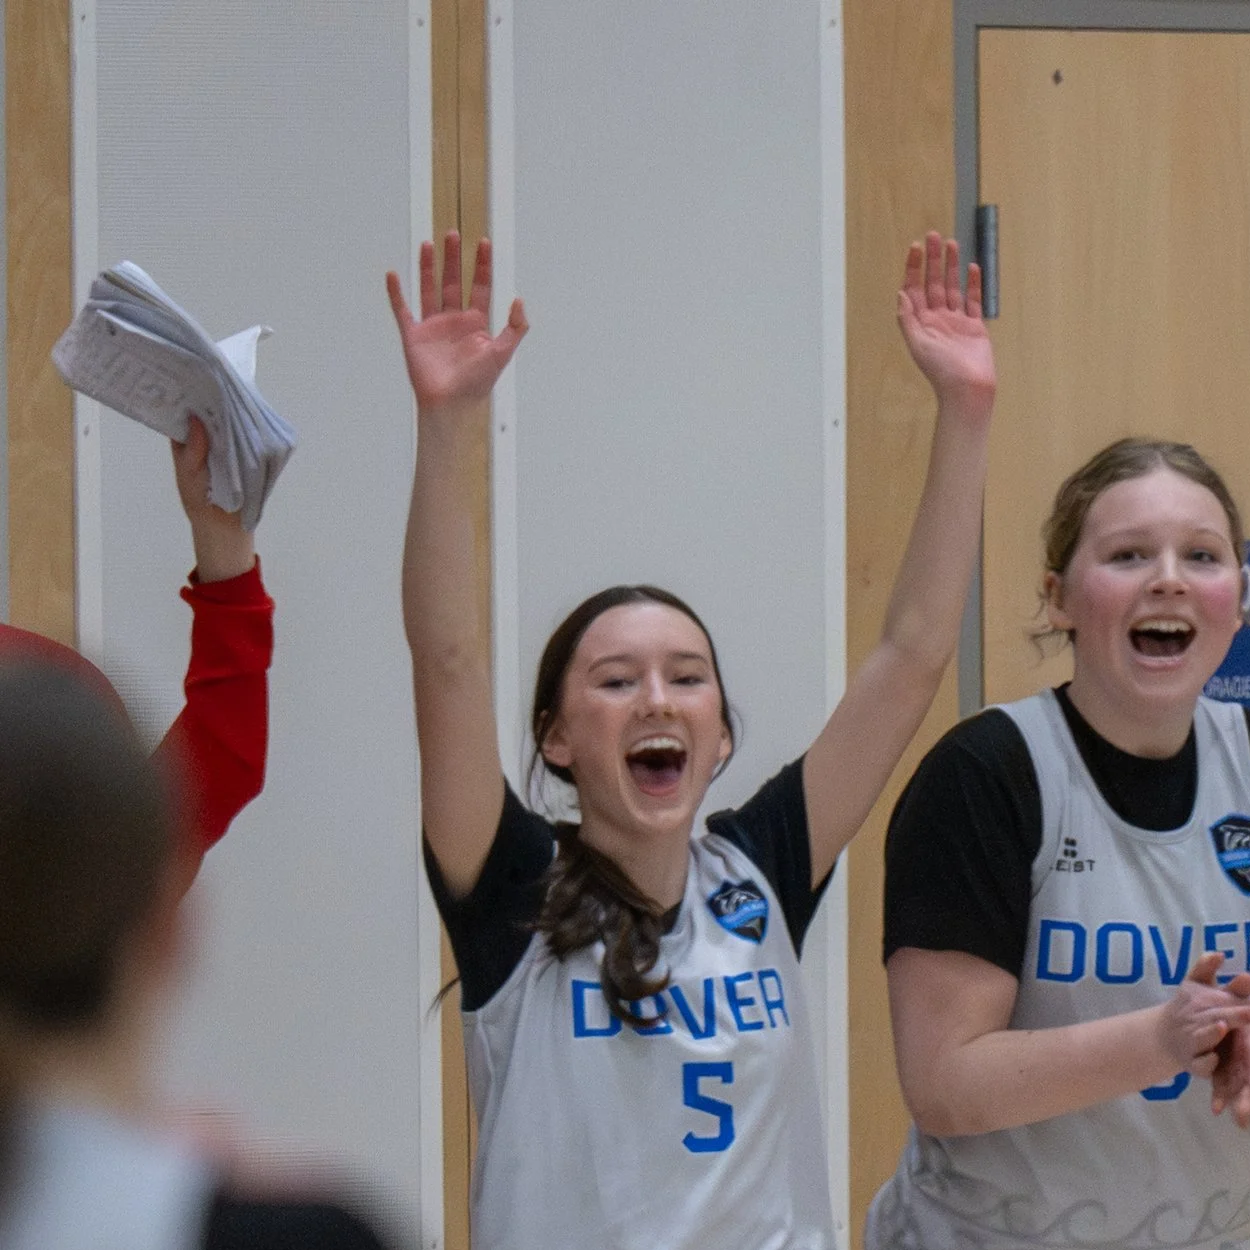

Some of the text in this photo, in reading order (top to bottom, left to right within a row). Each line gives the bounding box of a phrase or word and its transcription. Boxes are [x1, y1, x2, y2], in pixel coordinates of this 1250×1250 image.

[1050, 859, 1096, 873] EIST
[571, 968, 789, 1040] DOVER
[682, 1062, 735, 1153] 5
